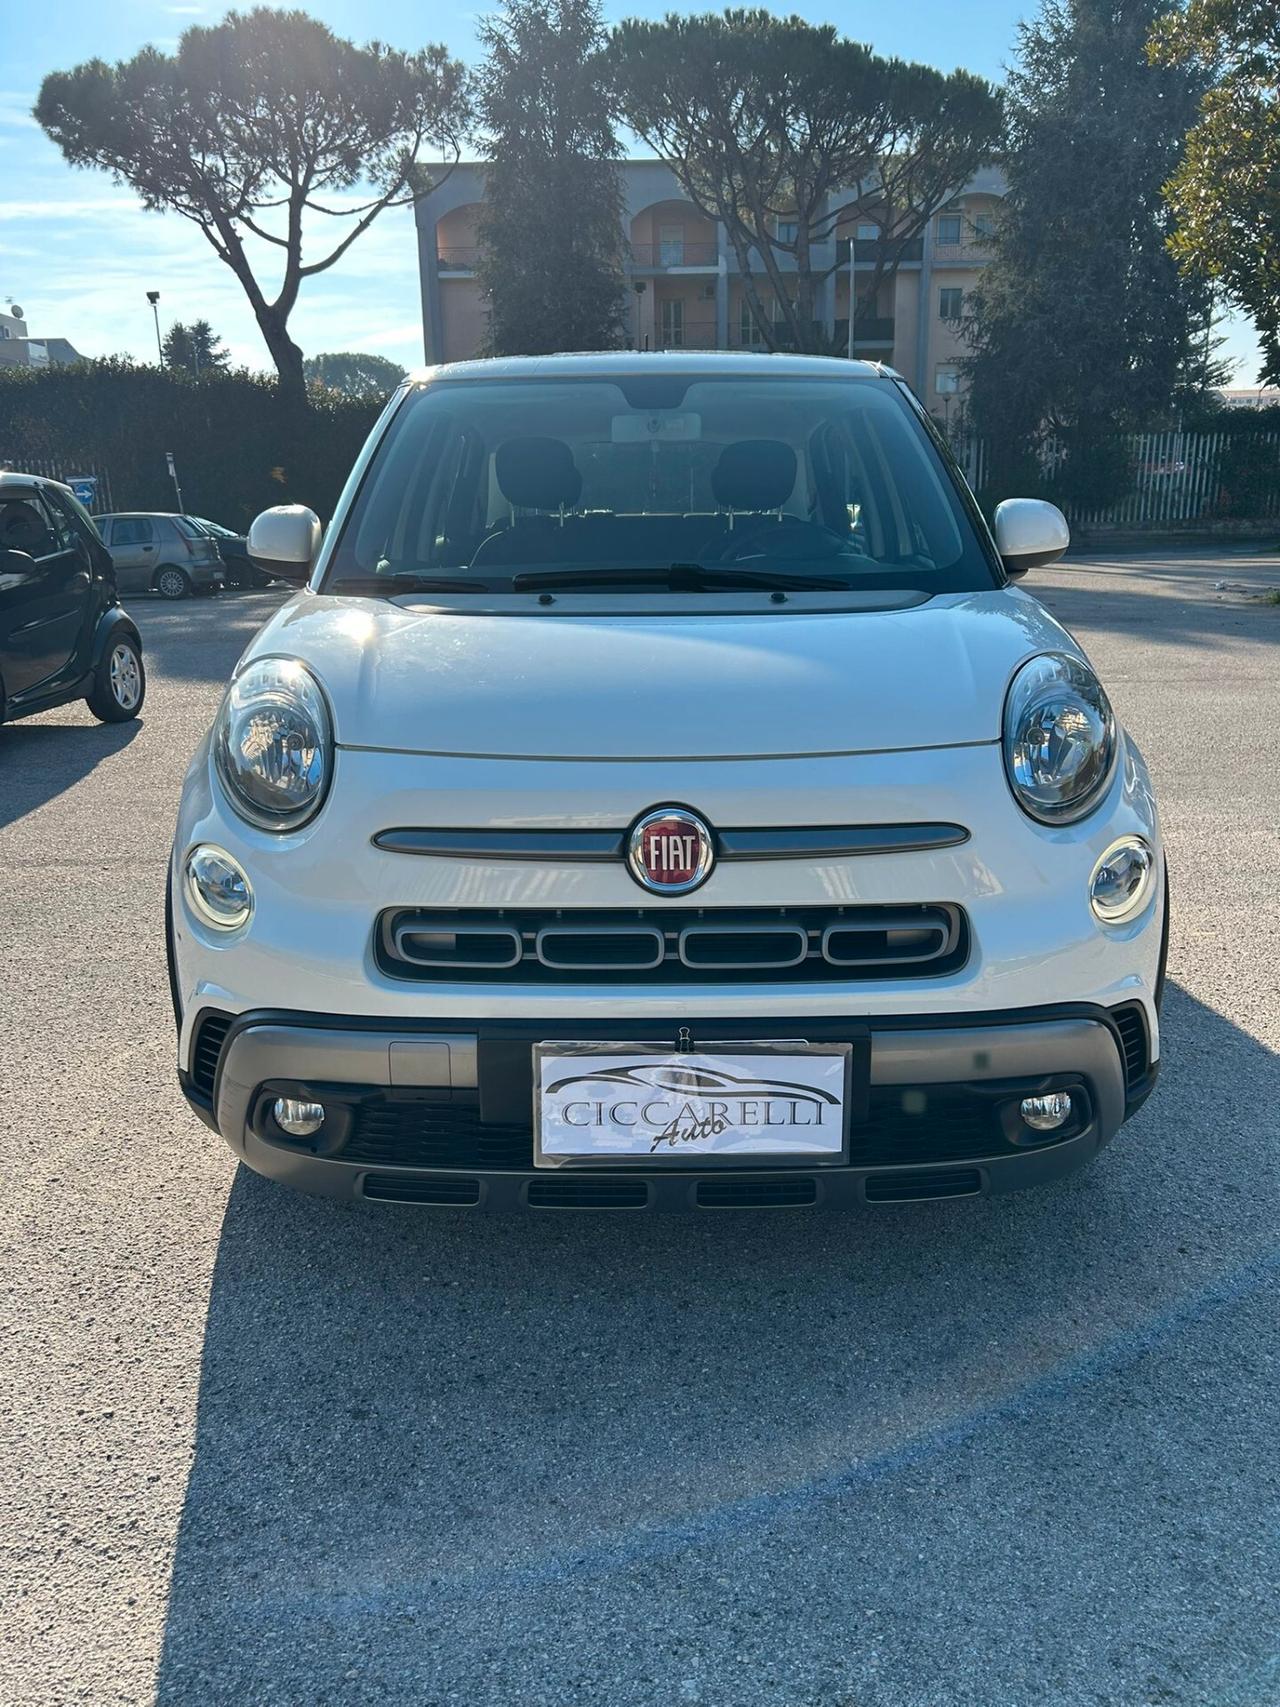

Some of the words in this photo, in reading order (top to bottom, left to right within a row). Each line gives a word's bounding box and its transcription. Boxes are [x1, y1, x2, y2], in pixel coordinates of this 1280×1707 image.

[649, 835, 696, 871] FIAT
[561, 1101, 824, 1126] CICCARELLI
[650, 1117, 727, 1152] Auto
